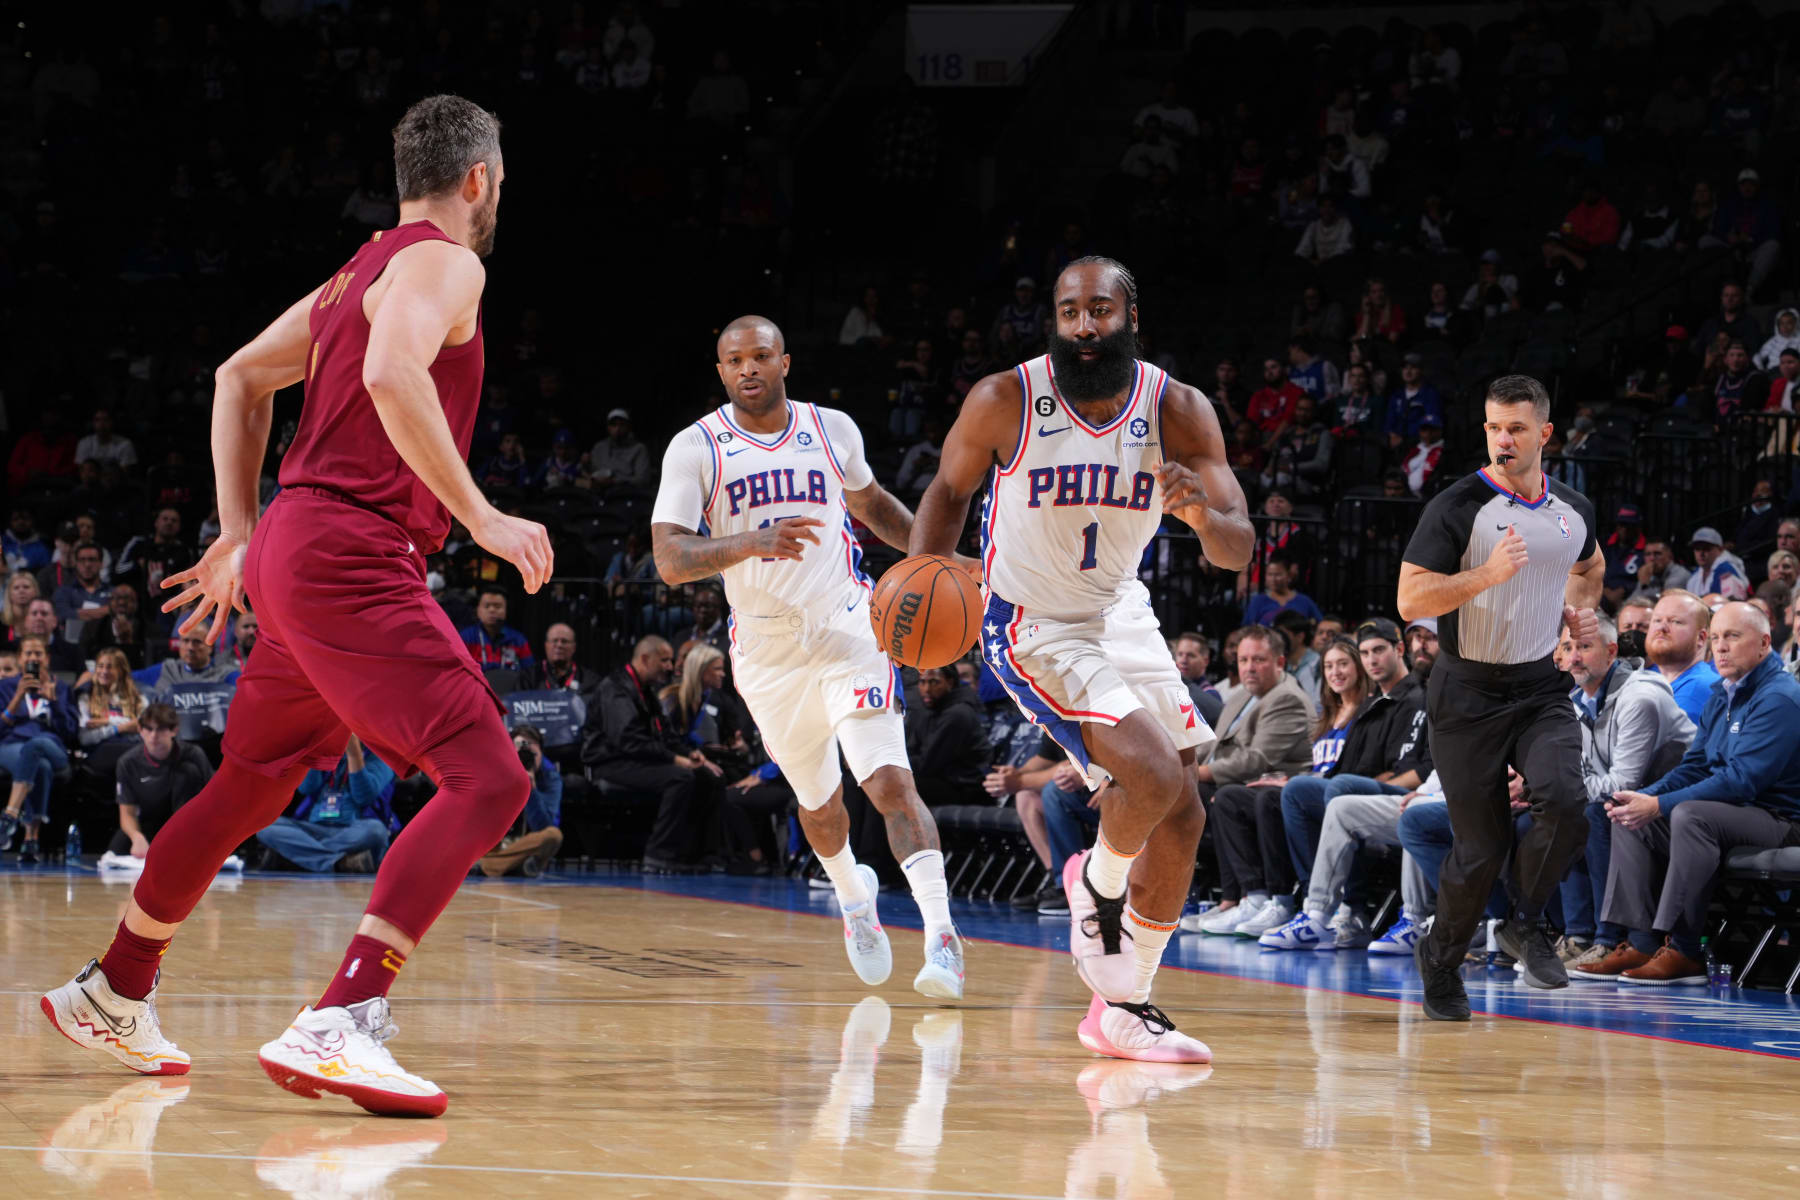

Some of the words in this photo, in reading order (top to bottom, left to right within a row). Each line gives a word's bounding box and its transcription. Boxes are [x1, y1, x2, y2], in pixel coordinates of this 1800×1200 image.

[917, 53, 963, 81] 118
[1039, 398, 1051, 415] 6
[725, 468, 827, 516] PHILA
[1028, 463, 1155, 511] PHILA
[1080, 522, 1098, 571] 1
[1624, 553, 1638, 575] 6
[891, 591, 925, 659] Wilson
[173, 692, 204, 710] NJM
[513, 700, 544, 717] NJM
[853, 686, 883, 709] 76
